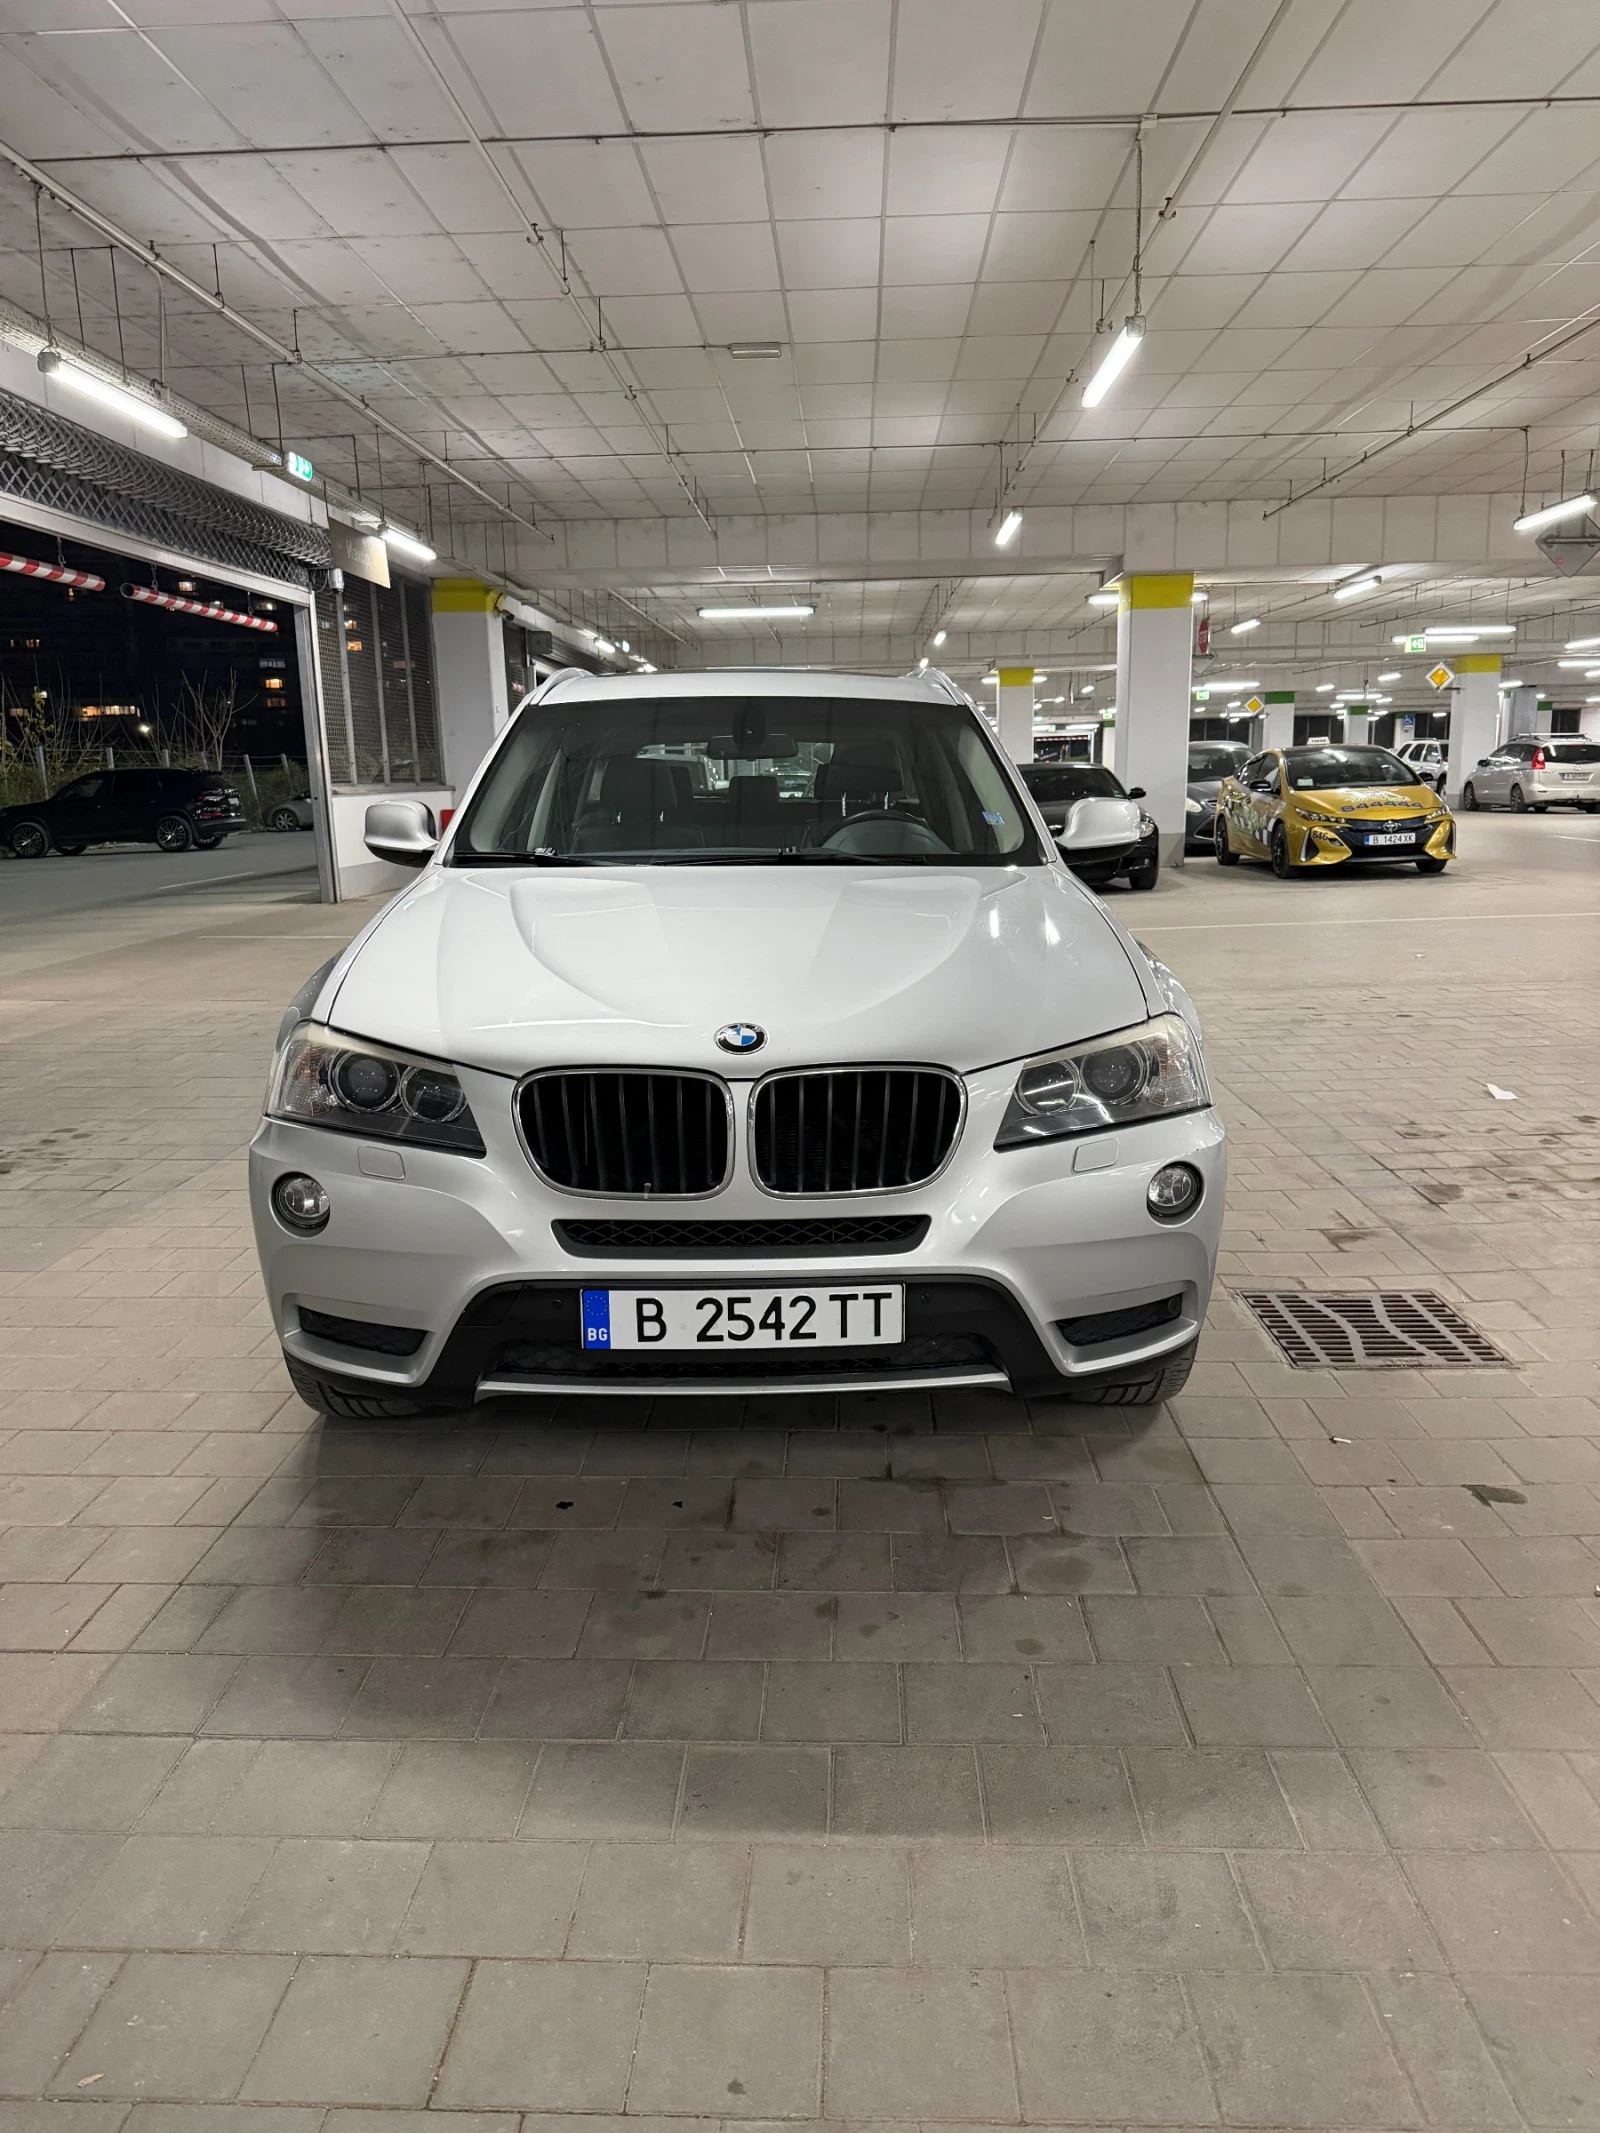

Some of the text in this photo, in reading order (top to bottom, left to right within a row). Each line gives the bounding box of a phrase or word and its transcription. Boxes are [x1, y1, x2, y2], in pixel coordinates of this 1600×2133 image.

[1312, 831, 1329, 841] 846
[1373, 833, 1415, 845] B 1424 XK
[635, 1292, 893, 1343] B 2542 TT
[587, 1327, 608, 1341] BG
